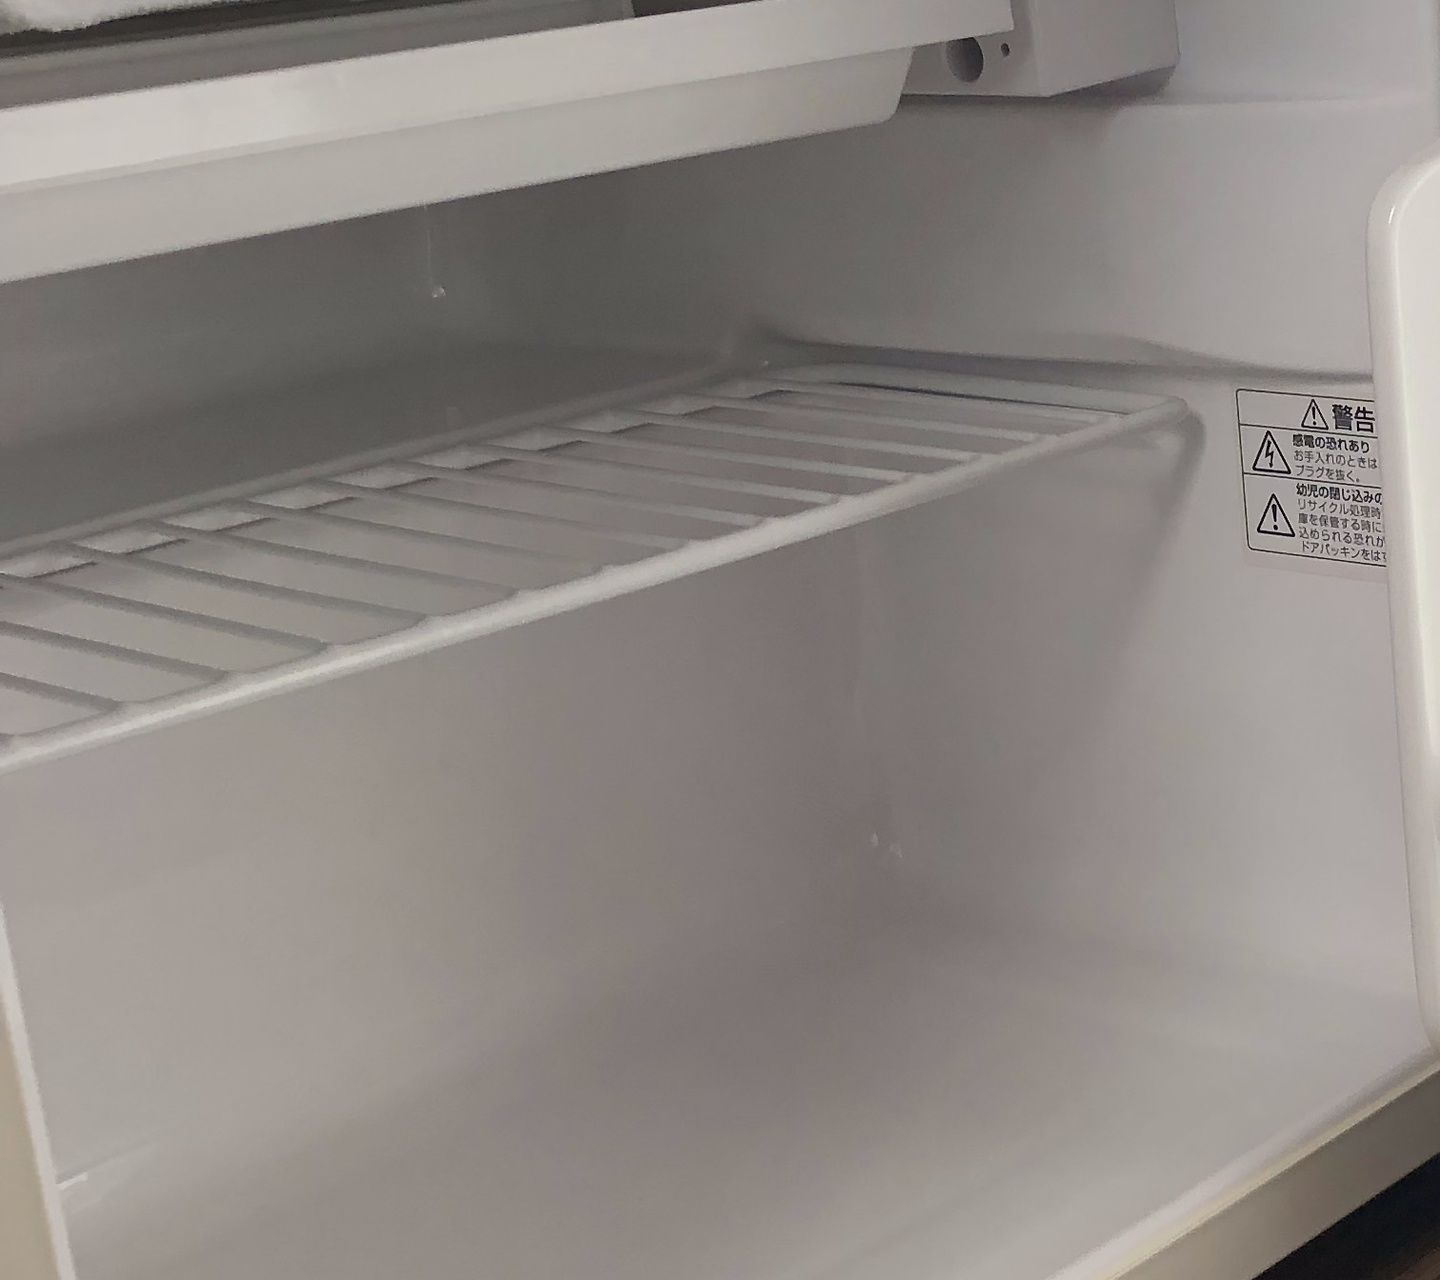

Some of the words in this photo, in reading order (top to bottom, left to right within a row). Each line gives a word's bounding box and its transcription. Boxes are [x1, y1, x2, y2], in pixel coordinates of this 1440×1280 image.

[1332, 404, 1376, 434] 警告
[1293, 434, 1370, 453] 感電の恐れあり
[1294, 450, 1378, 469] お手入れのときは
